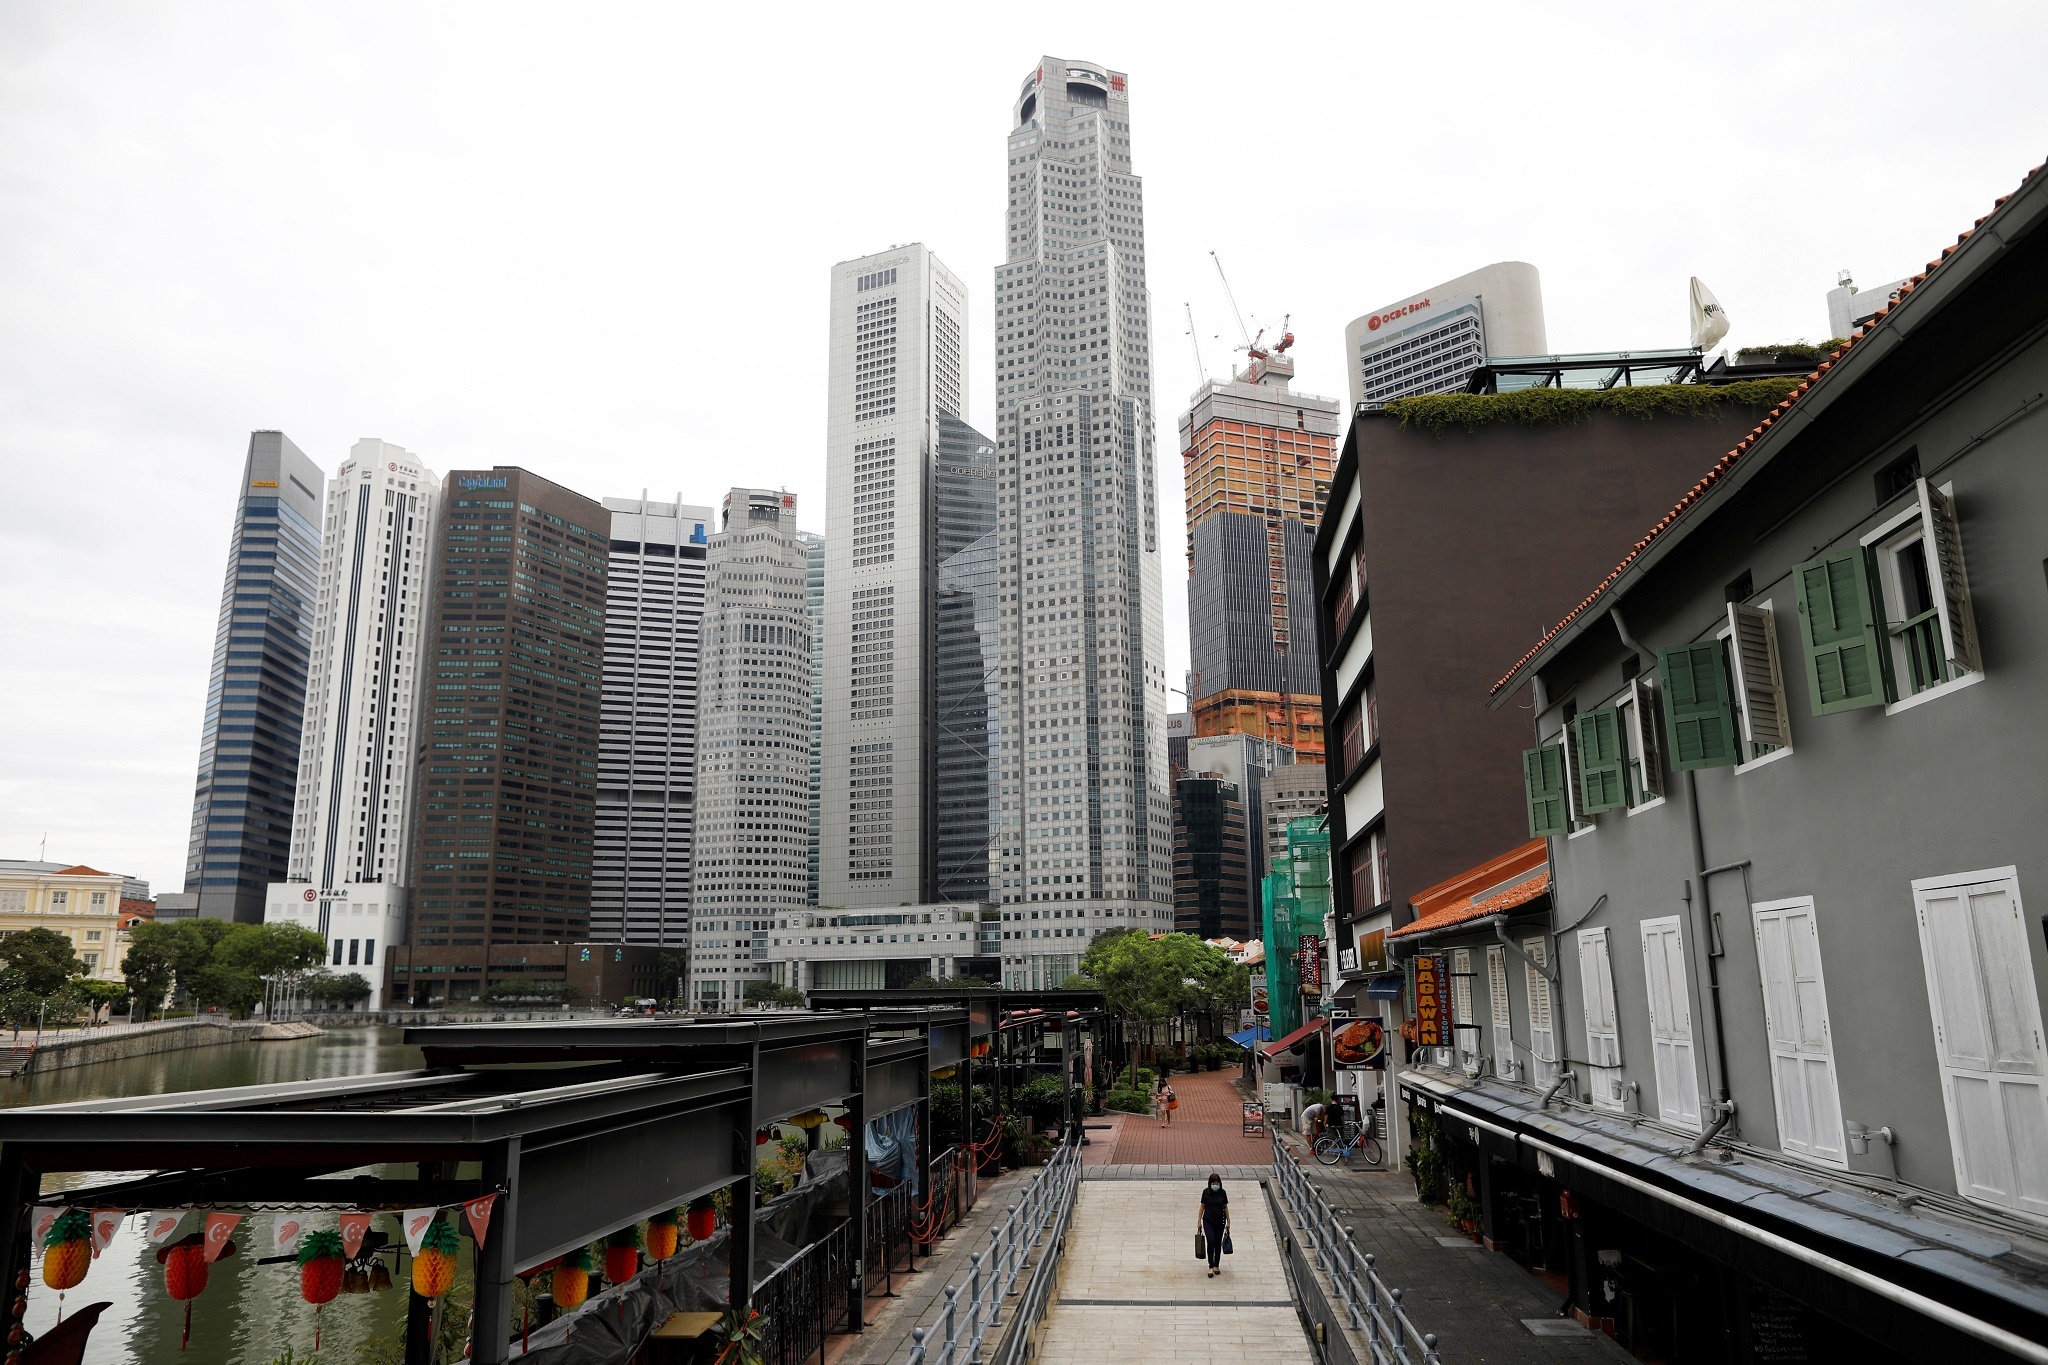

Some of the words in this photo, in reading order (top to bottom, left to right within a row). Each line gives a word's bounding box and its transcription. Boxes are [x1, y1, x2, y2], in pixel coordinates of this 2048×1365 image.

[1382, 307, 1407, 323] OCBC
[1409, 298, 1430, 313] Bank
[780, 508, 797, 517] UOB
[1438, 959, 1446, 987] INDIAN
[1418, 958, 1438, 1045] BAGAWAN
[1439, 989, 1448, 1014] MUSIC
[1441, 1016, 1449, 1045] LOUNGE
